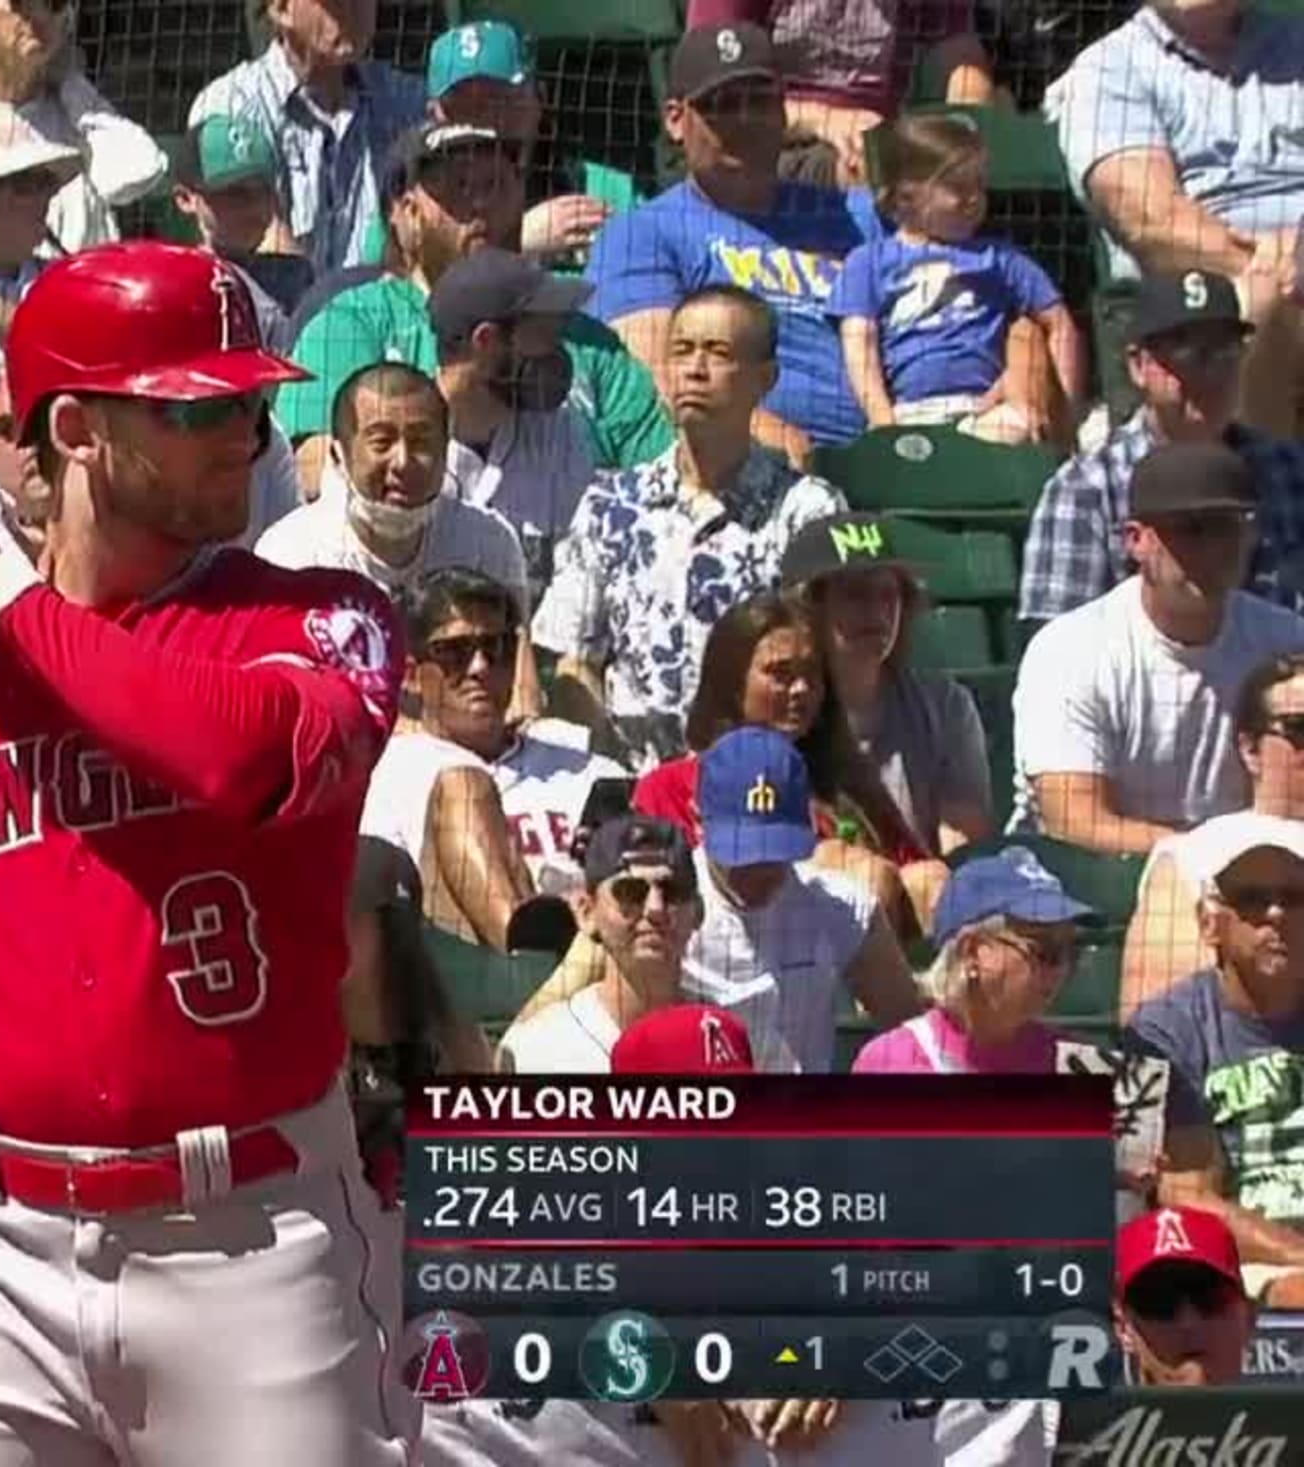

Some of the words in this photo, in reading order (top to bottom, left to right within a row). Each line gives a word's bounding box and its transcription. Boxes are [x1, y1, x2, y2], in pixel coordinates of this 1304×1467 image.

[1183, 271, 1208, 308] S
[161, 870, 268, 1026] 3
[1058, 1405, 1288, 1467] Alaska
